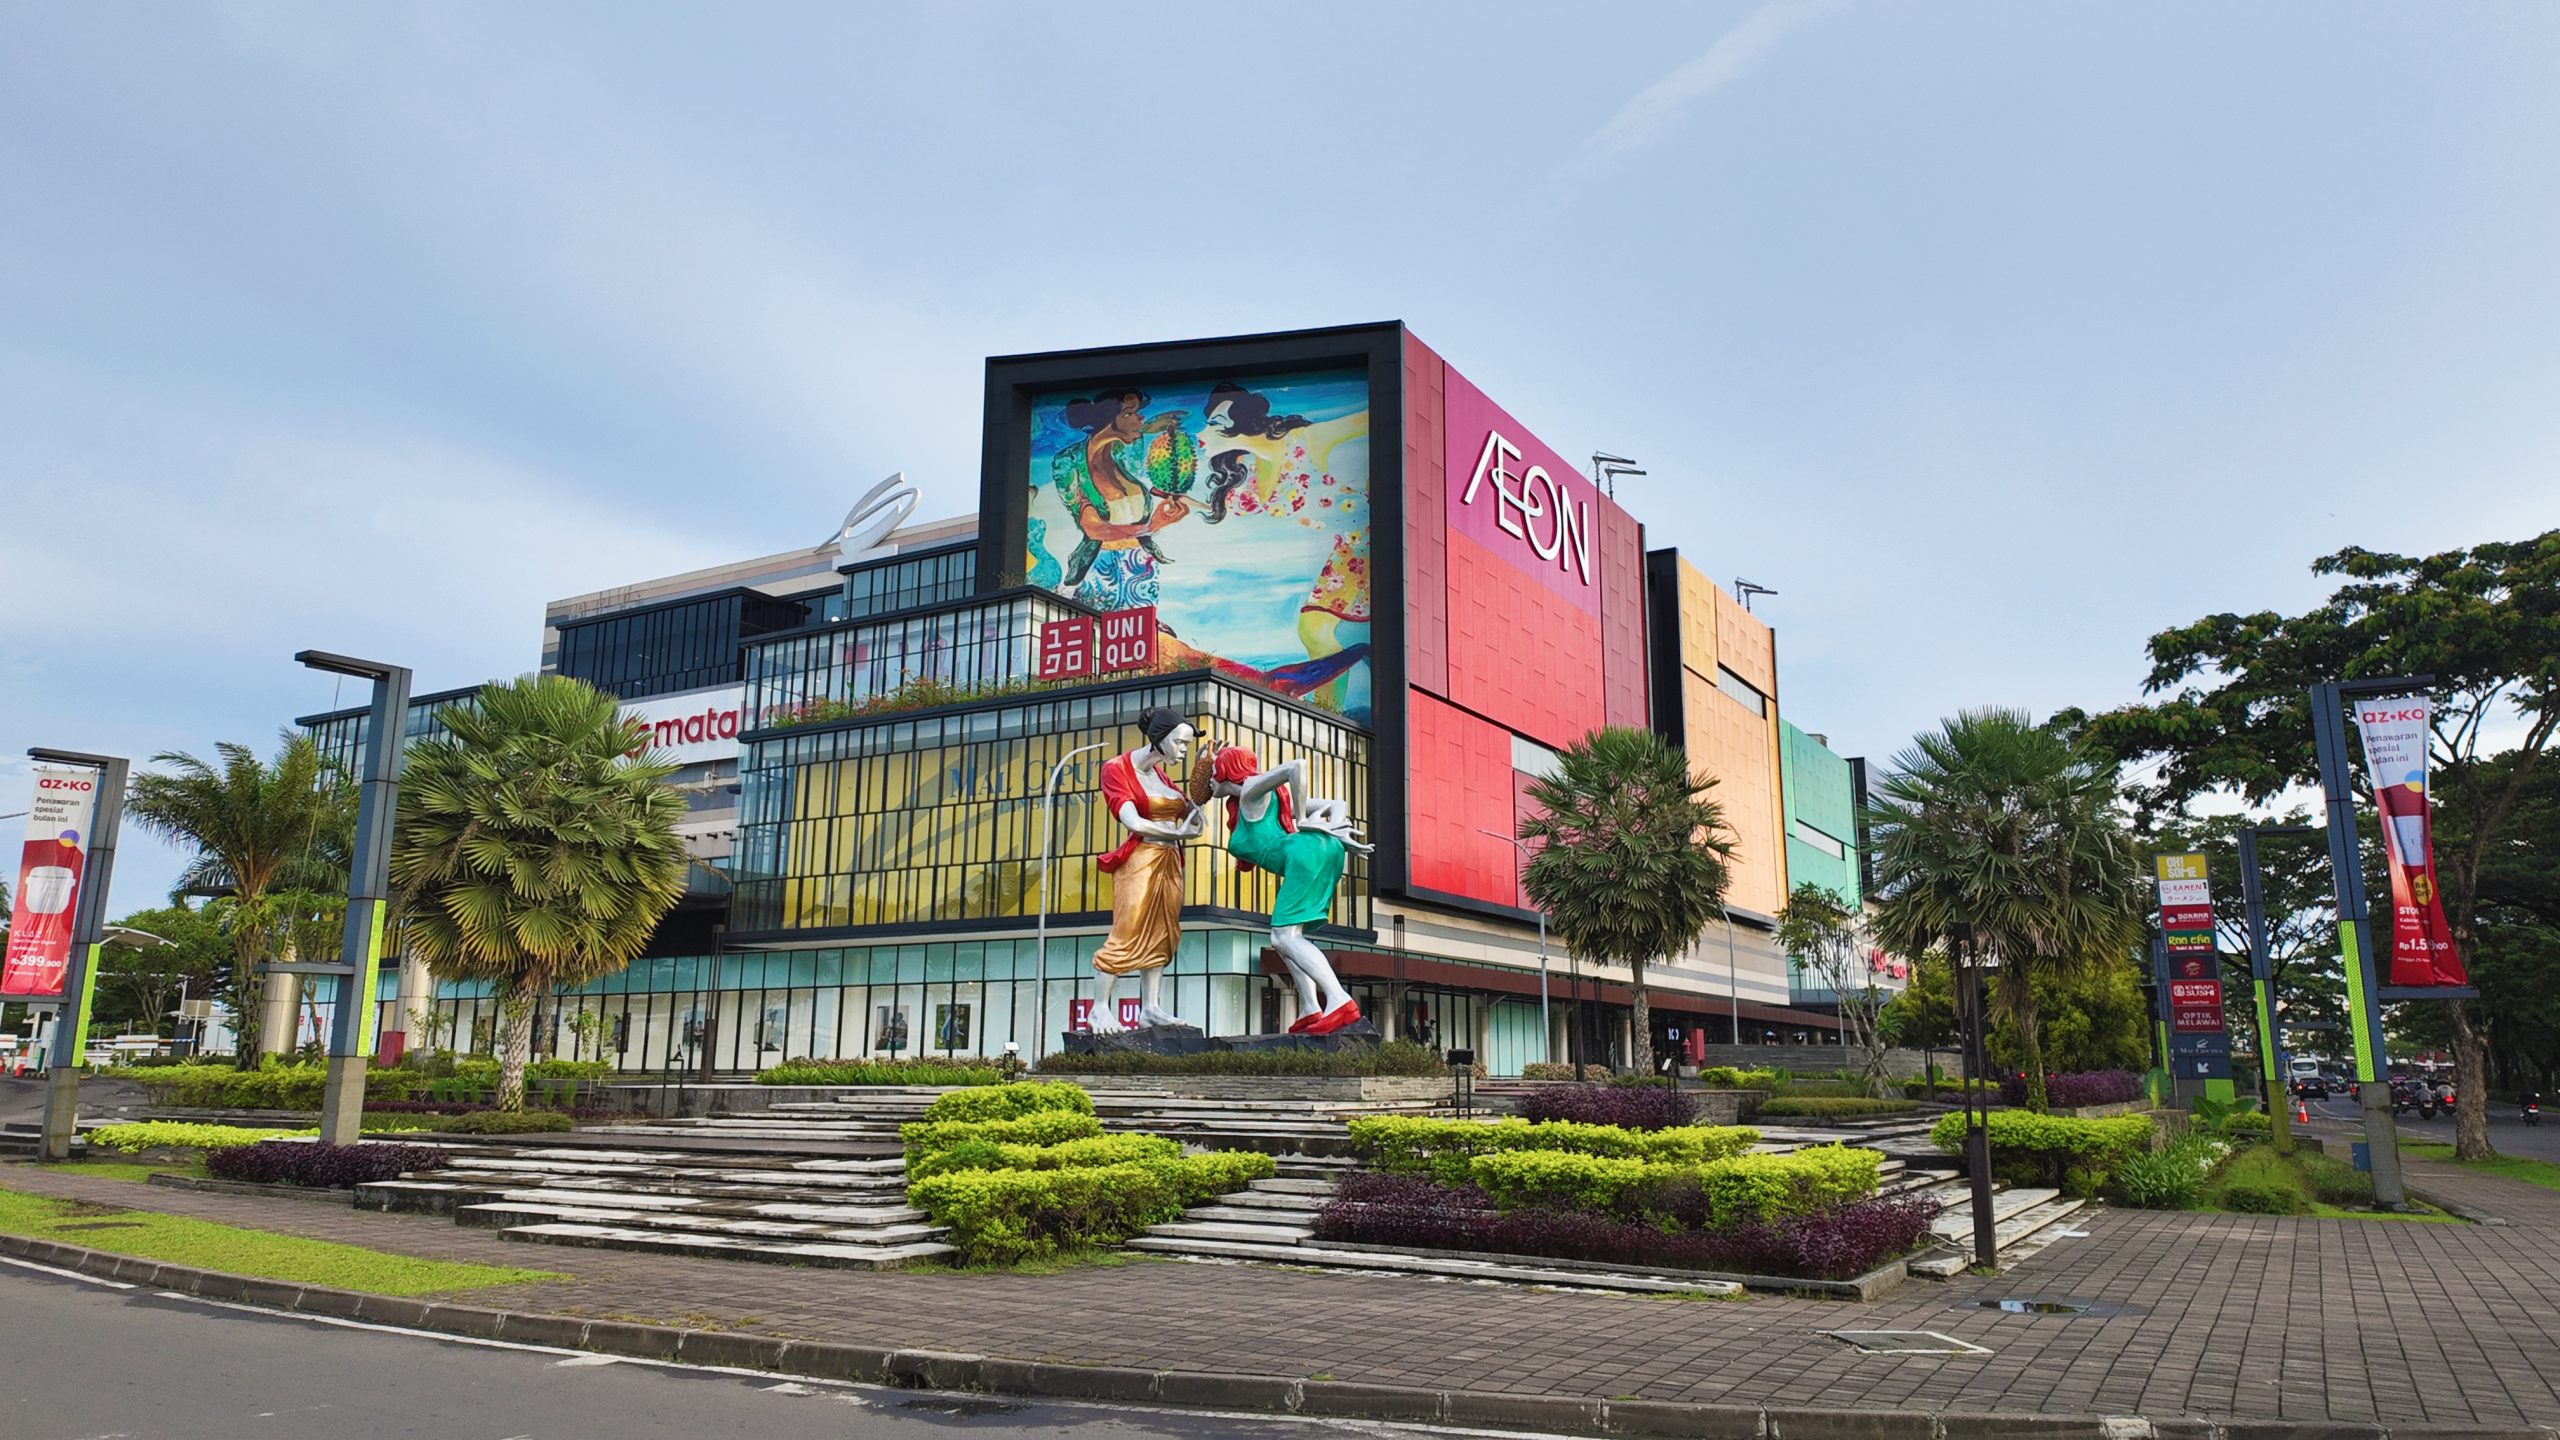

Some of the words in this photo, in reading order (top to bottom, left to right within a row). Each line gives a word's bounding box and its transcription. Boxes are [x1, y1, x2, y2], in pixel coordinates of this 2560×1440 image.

[1106, 615, 1143, 640] UNI
[1106, 640, 1146, 668] QLO
[949, 767, 1012, 798] MAL
[36, 796, 80, 806] Penawaran
[33, 814, 56, 822] bulan
